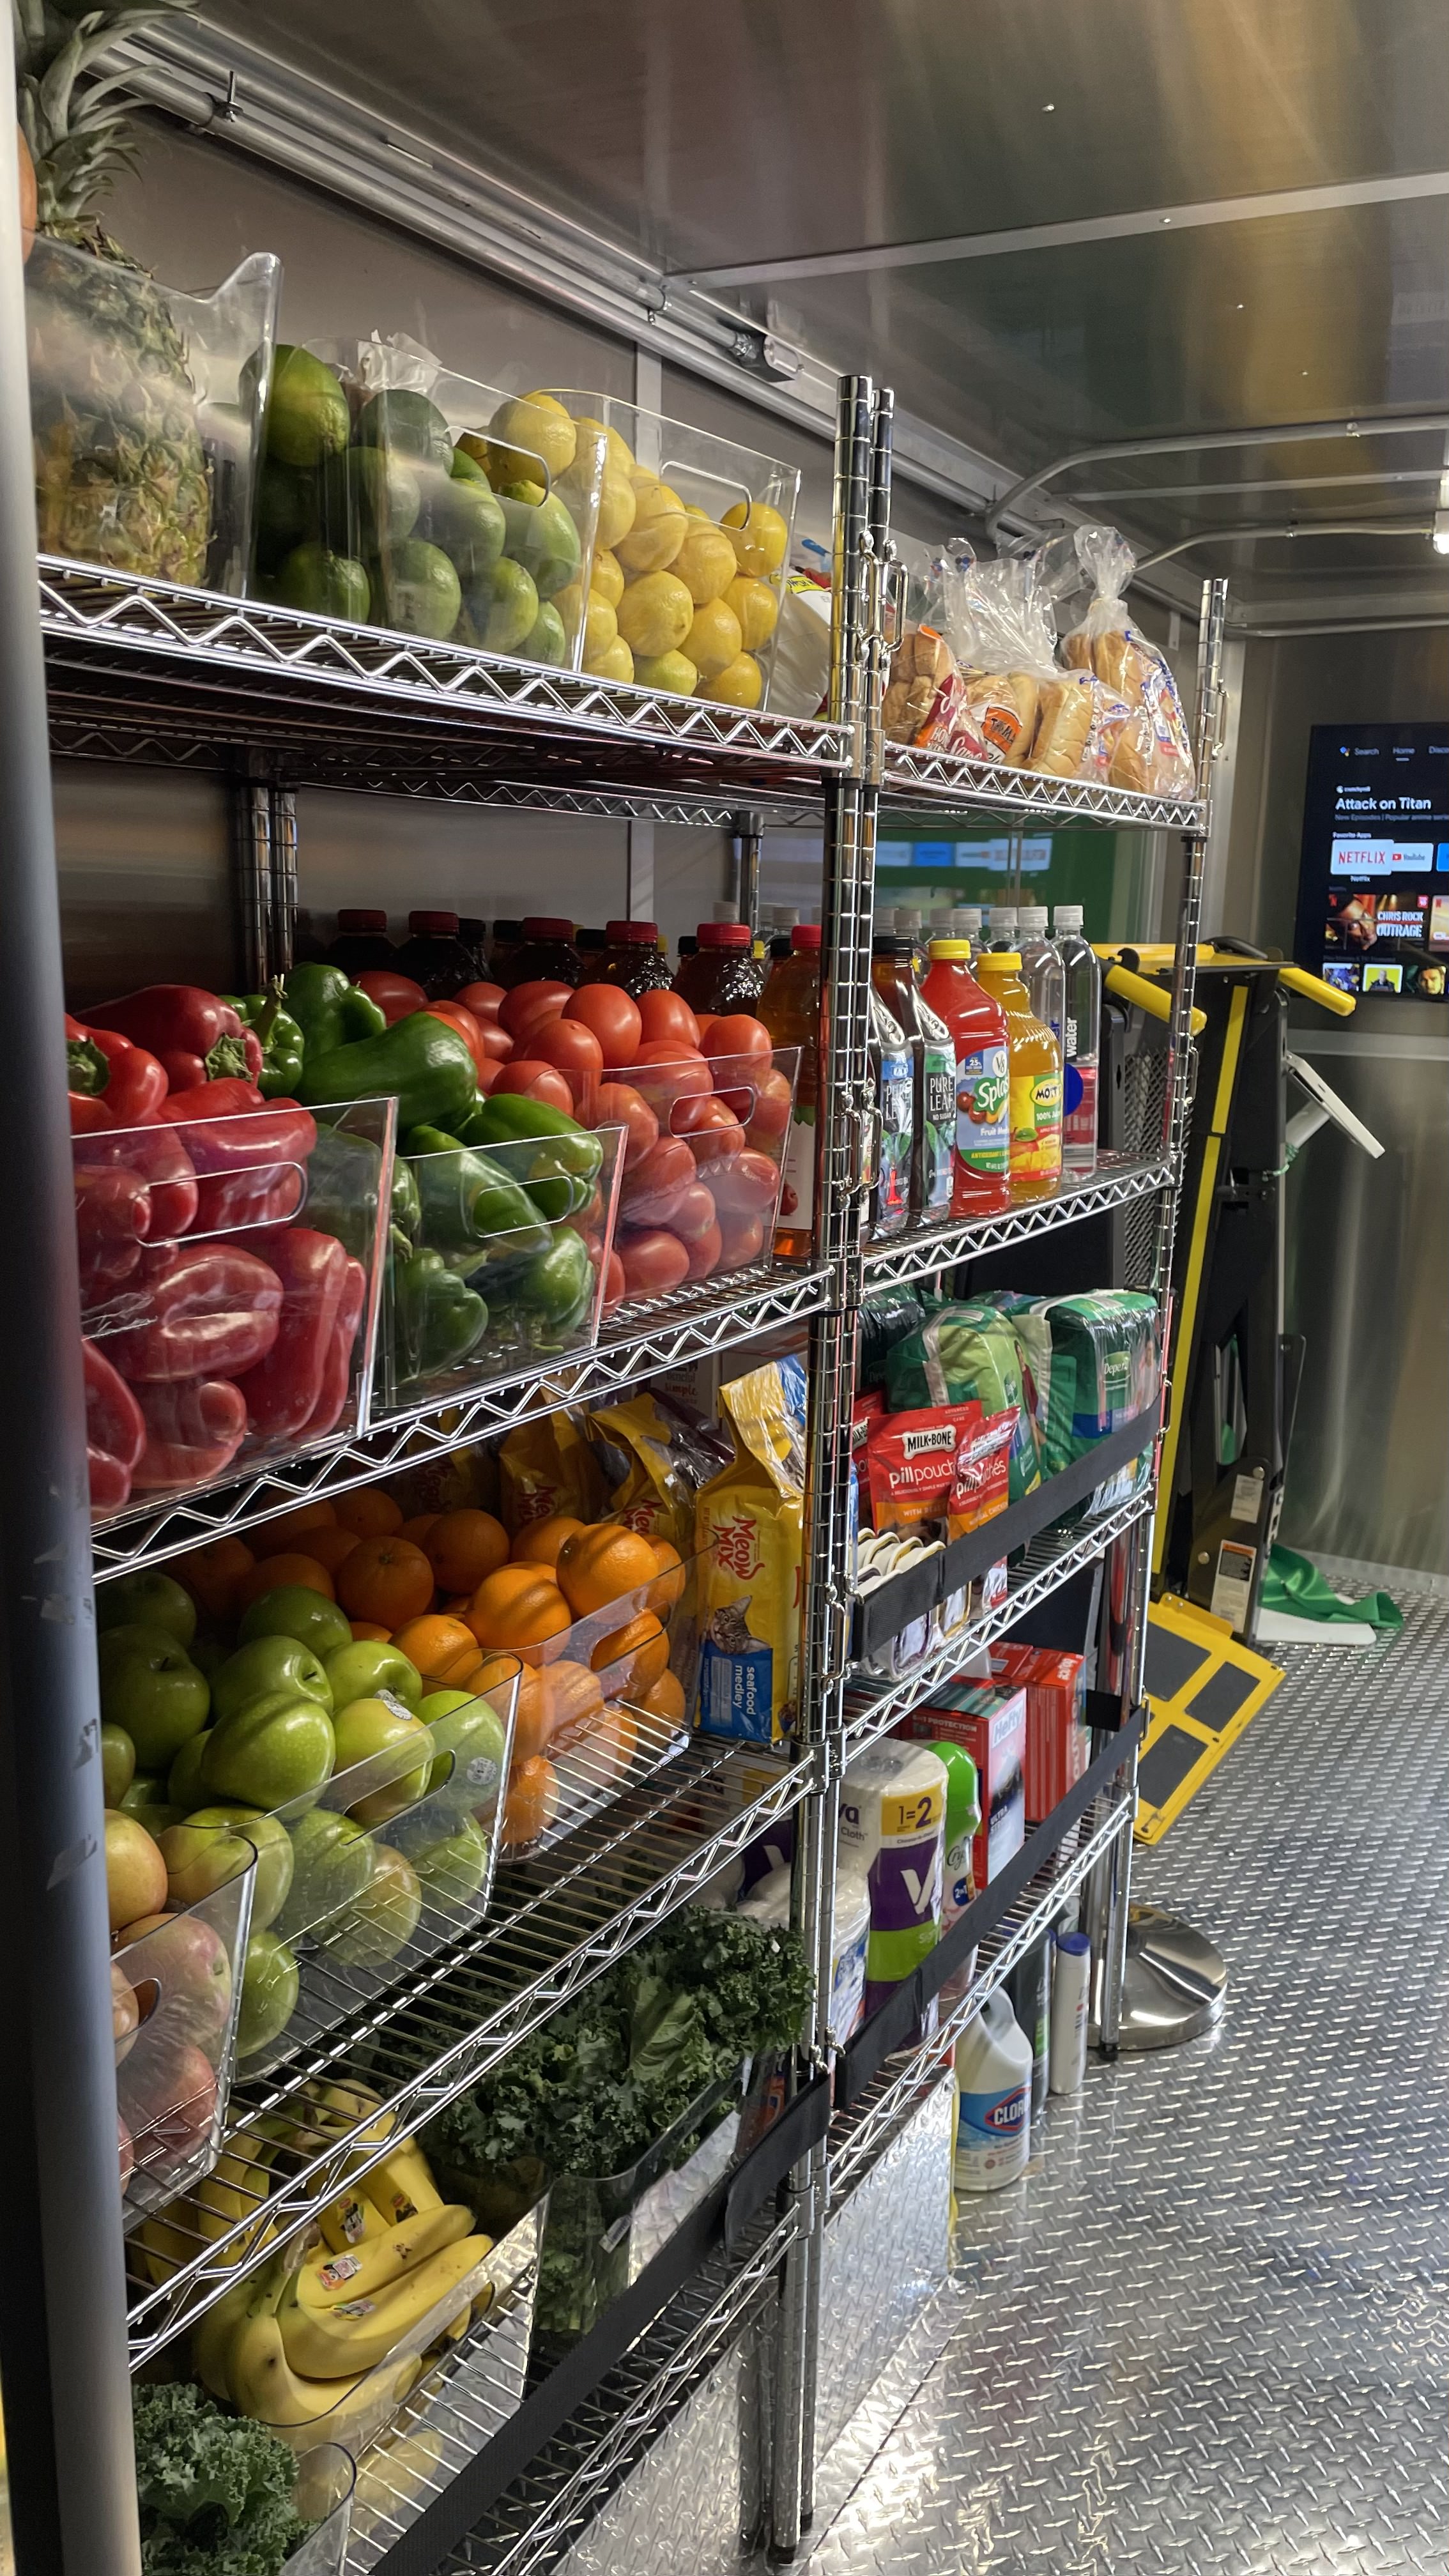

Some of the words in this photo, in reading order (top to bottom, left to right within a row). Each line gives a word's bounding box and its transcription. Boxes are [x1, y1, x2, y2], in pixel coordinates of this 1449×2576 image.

[1354, 747, 1379, 756] Search
[1392, 746, 1415, 755] Home
[1429, 746, 1449, 755] Disco
[1335, 797, 1377, 810] Attack
[1379, 799, 1397, 810] on
[1399, 797, 1432, 810] Titan
[1338, 851, 1385, 864] NETFLIX
[1404, 853, 1425, 861] YouTube
[1377, 911, 1401, 921] CHRIS
[1402, 911, 1423, 922] ROCK
[1376, 924, 1422, 938] OUTRAGE
[1066, 1017, 1078, 1058] water
[995, 1054, 1006, 1073] V8
[930, 1076, 954, 1094] PURE
[978, 1077, 1009, 1111] Splas
[930, 1094, 954, 1112] LEAF
[1036, 1112, 1052, 1121] 100%
[980, 1126, 997, 1136] Fruit
[638, 1499, 663, 1534] Meo
[903, 1508, 922, 1517] WITH
[732, 1515, 765, 1580] Meow
[733, 1664, 744, 1709] medley
[746, 1665, 756, 1715] seafood
[927, 1717, 977, 1733] PROTECTION
[993, 1704, 1023, 1744] Hefty
[993, 2099, 1026, 2126] CLOR
